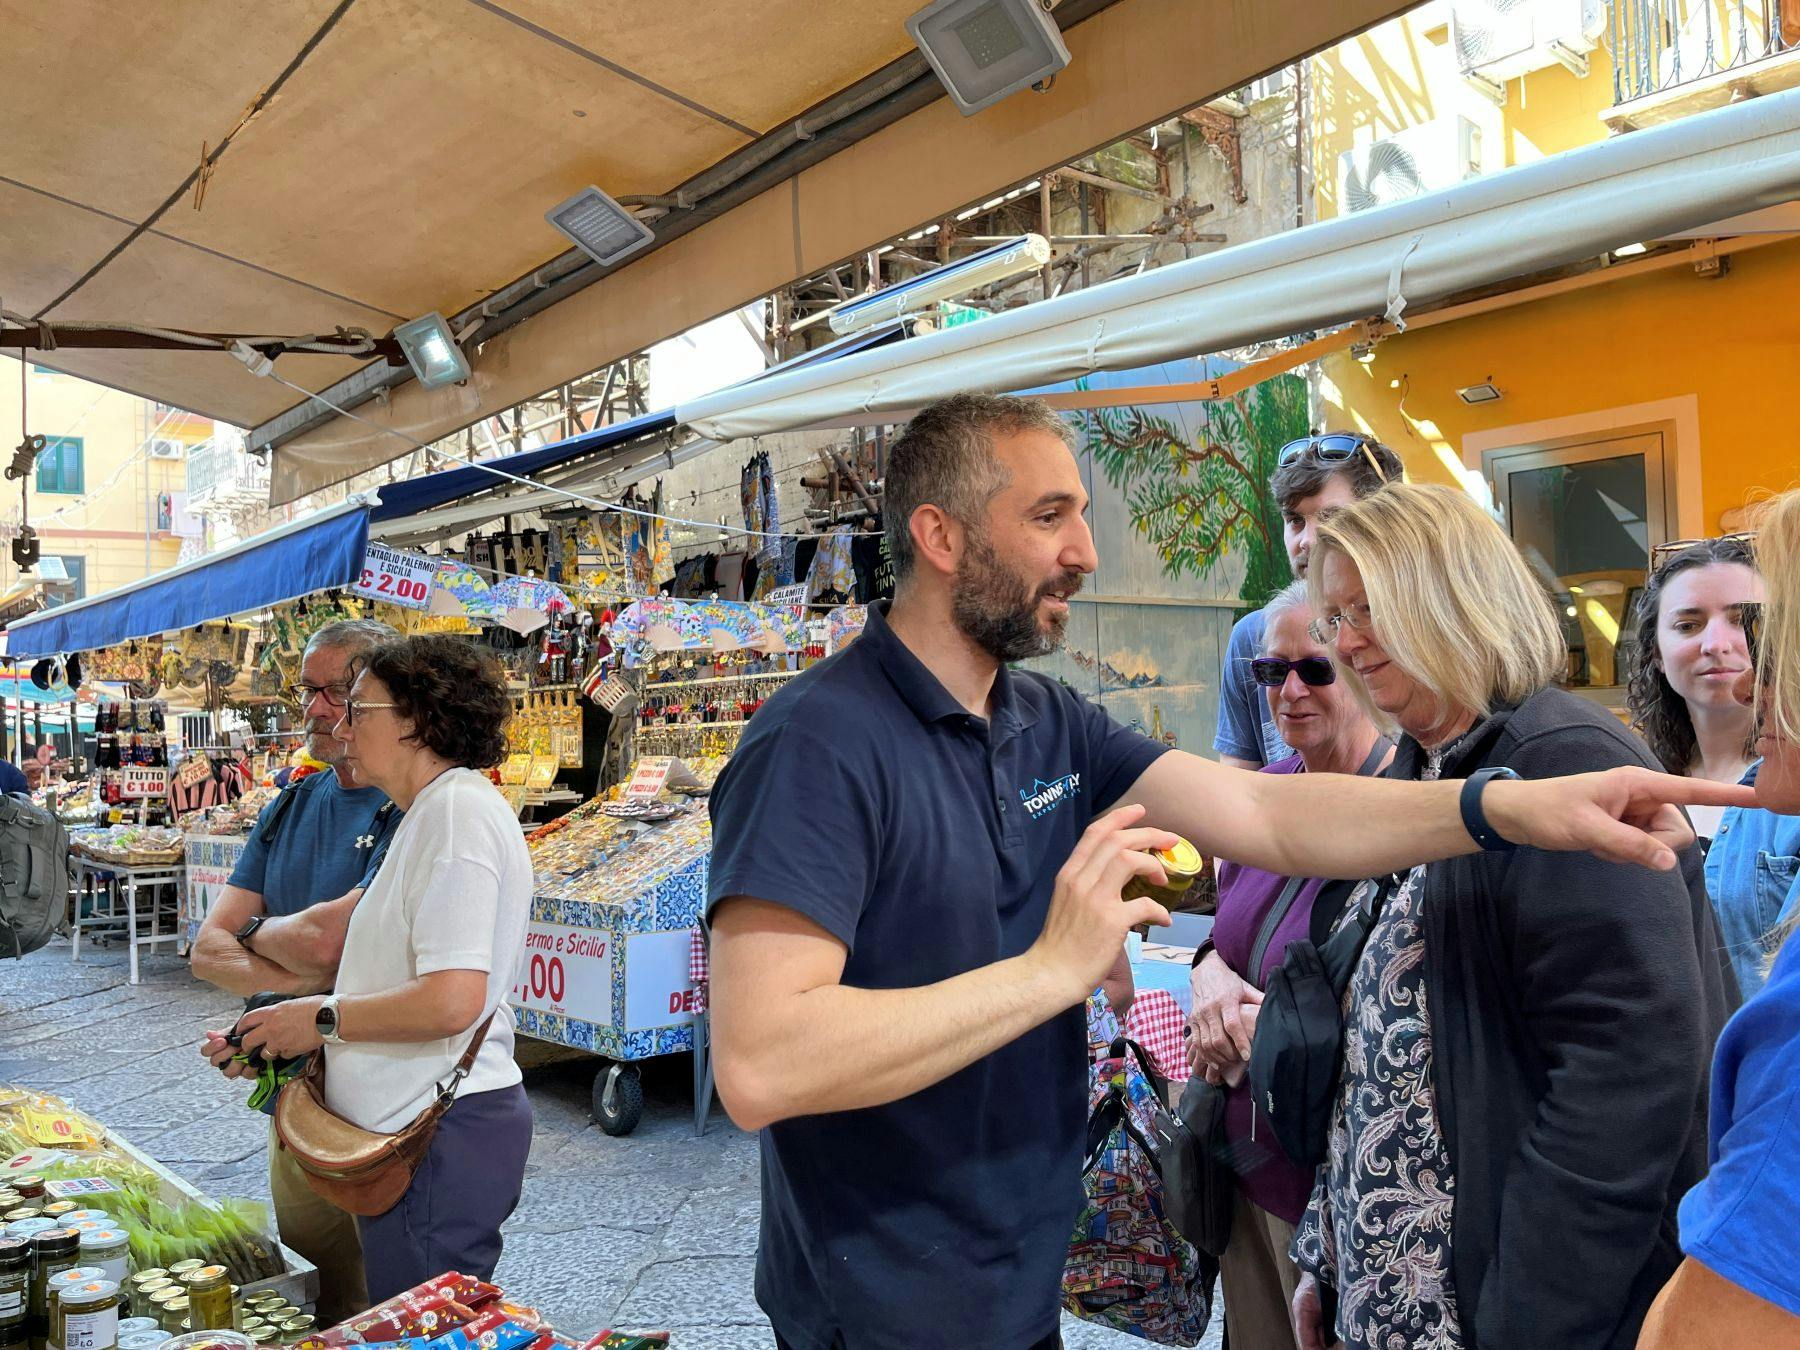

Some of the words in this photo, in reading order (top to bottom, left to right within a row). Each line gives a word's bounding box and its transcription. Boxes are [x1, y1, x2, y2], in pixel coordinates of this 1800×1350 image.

[366, 547, 400, 564] ENTAGLIO
[401, 556, 435, 573] PALERMO
[380, 562, 385, 572] E
[386, 564, 412, 578] SICILIA
[377, 573, 427, 601] 2,00
[773, 587, 804, 599] CALAMITE
[129, 771, 164, 780] TUTTO
[127, 782, 135, 792] €
[526, 932, 552, 951] ermo
[556, 936, 563, 952] e
[566, 932, 606, 959] Sicilia
[514, 953, 565, 1003] ,00
